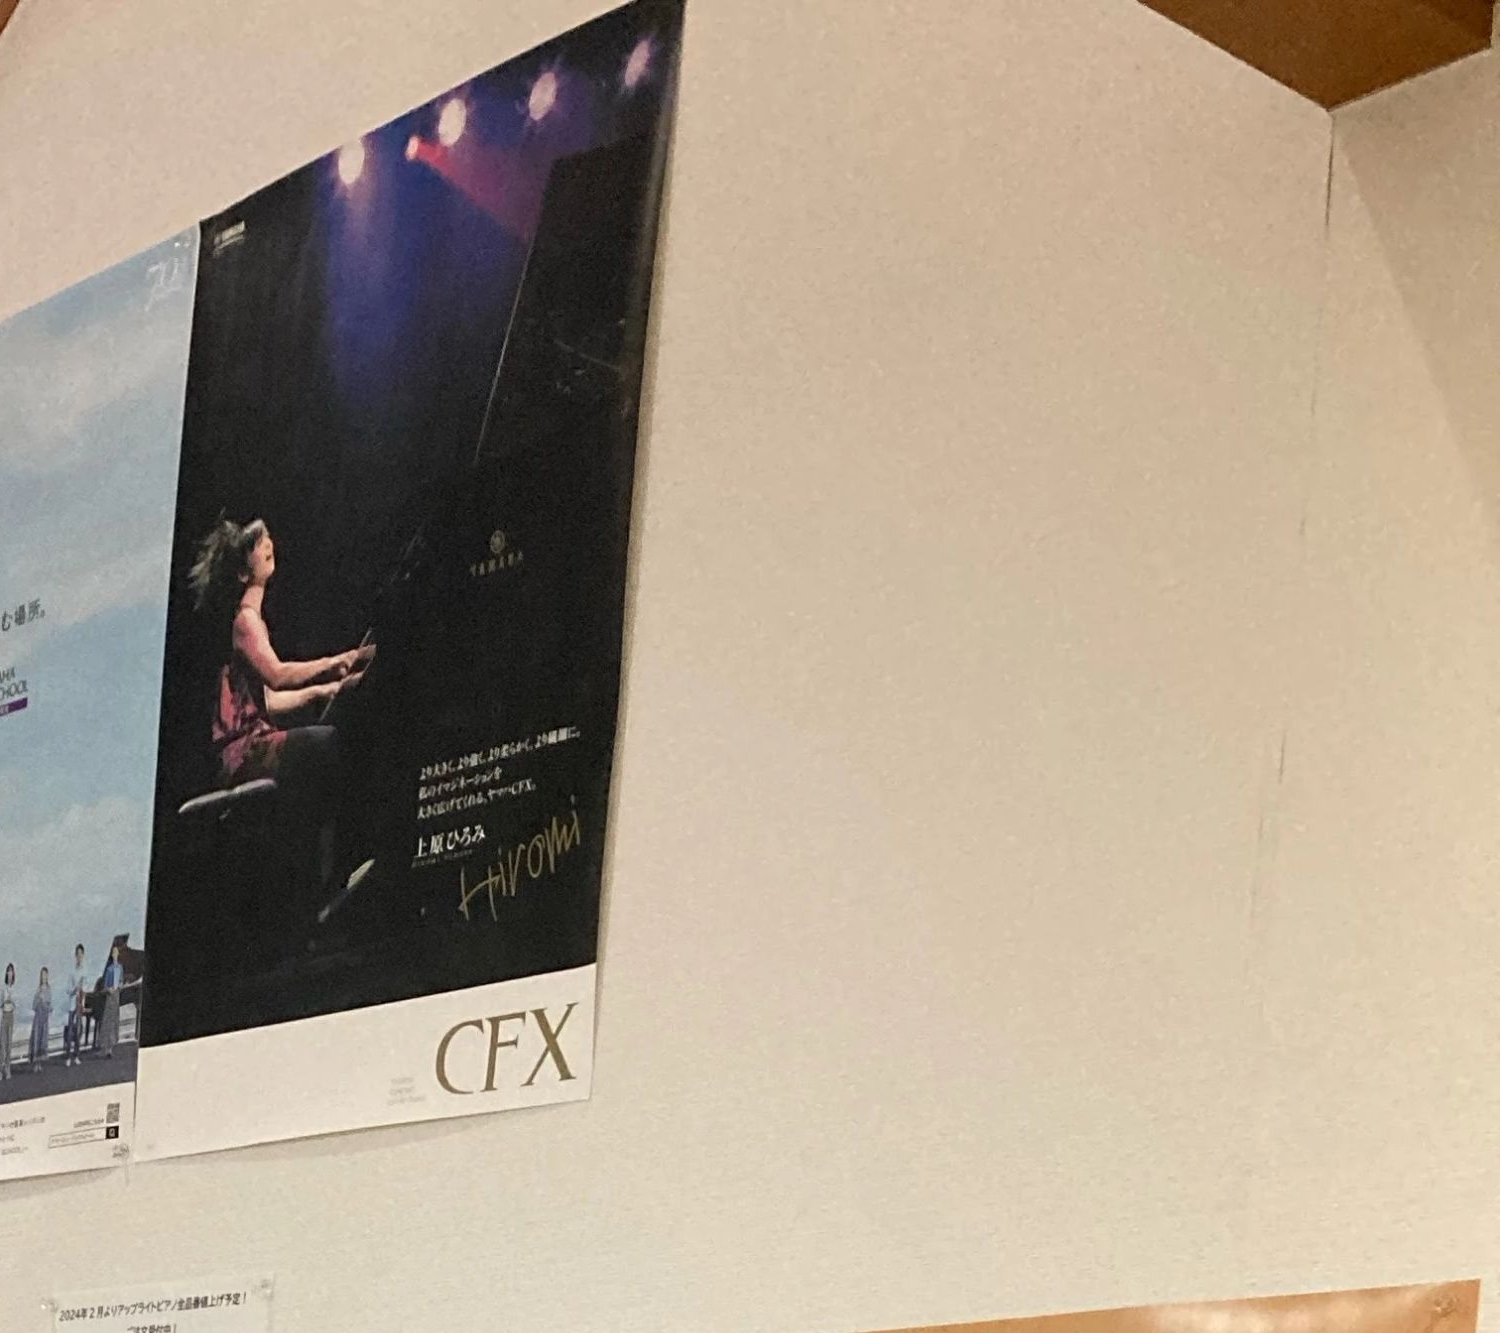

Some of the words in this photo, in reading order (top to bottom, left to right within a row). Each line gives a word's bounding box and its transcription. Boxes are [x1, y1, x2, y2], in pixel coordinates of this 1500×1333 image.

[413, 824, 485, 858] 上原ひろみ
[435, 1002, 579, 1095] CFX
